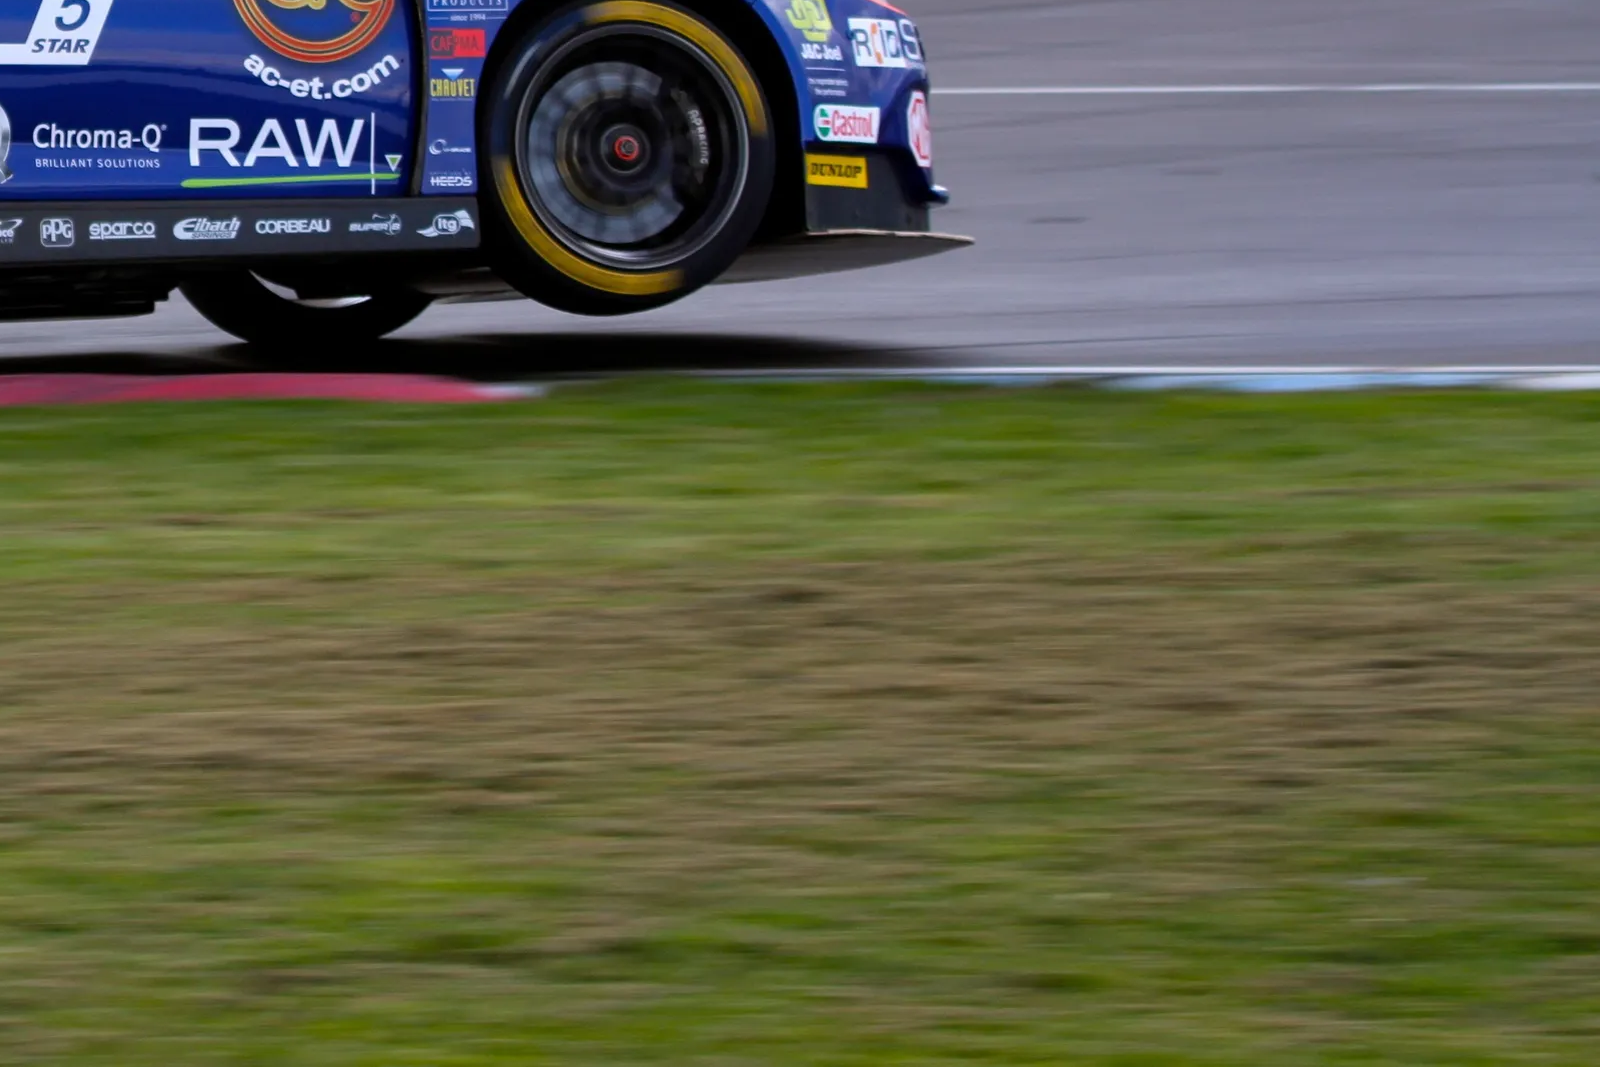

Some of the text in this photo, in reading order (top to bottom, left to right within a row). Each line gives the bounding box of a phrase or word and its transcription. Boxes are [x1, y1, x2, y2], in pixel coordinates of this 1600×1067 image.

[31, 38, 90, 54] STAR
[243, 53, 400, 100] ac-et.com
[430, 78, 475, 97] CHAUVET
[831, 111, 874, 137] Castrol
[32, 123, 162, 153] Chroma-Q
[189, 119, 364, 167] RAW
[35, 158, 160, 168] BRILLIANT SOLUTIONS
[809, 162, 862, 178] DUNLOP
[42, 218, 72, 242] PPG
[89, 220, 156, 239] sparco
[173, 215, 241, 240] Eibach
[255, 218, 331, 234] CORBEAU
